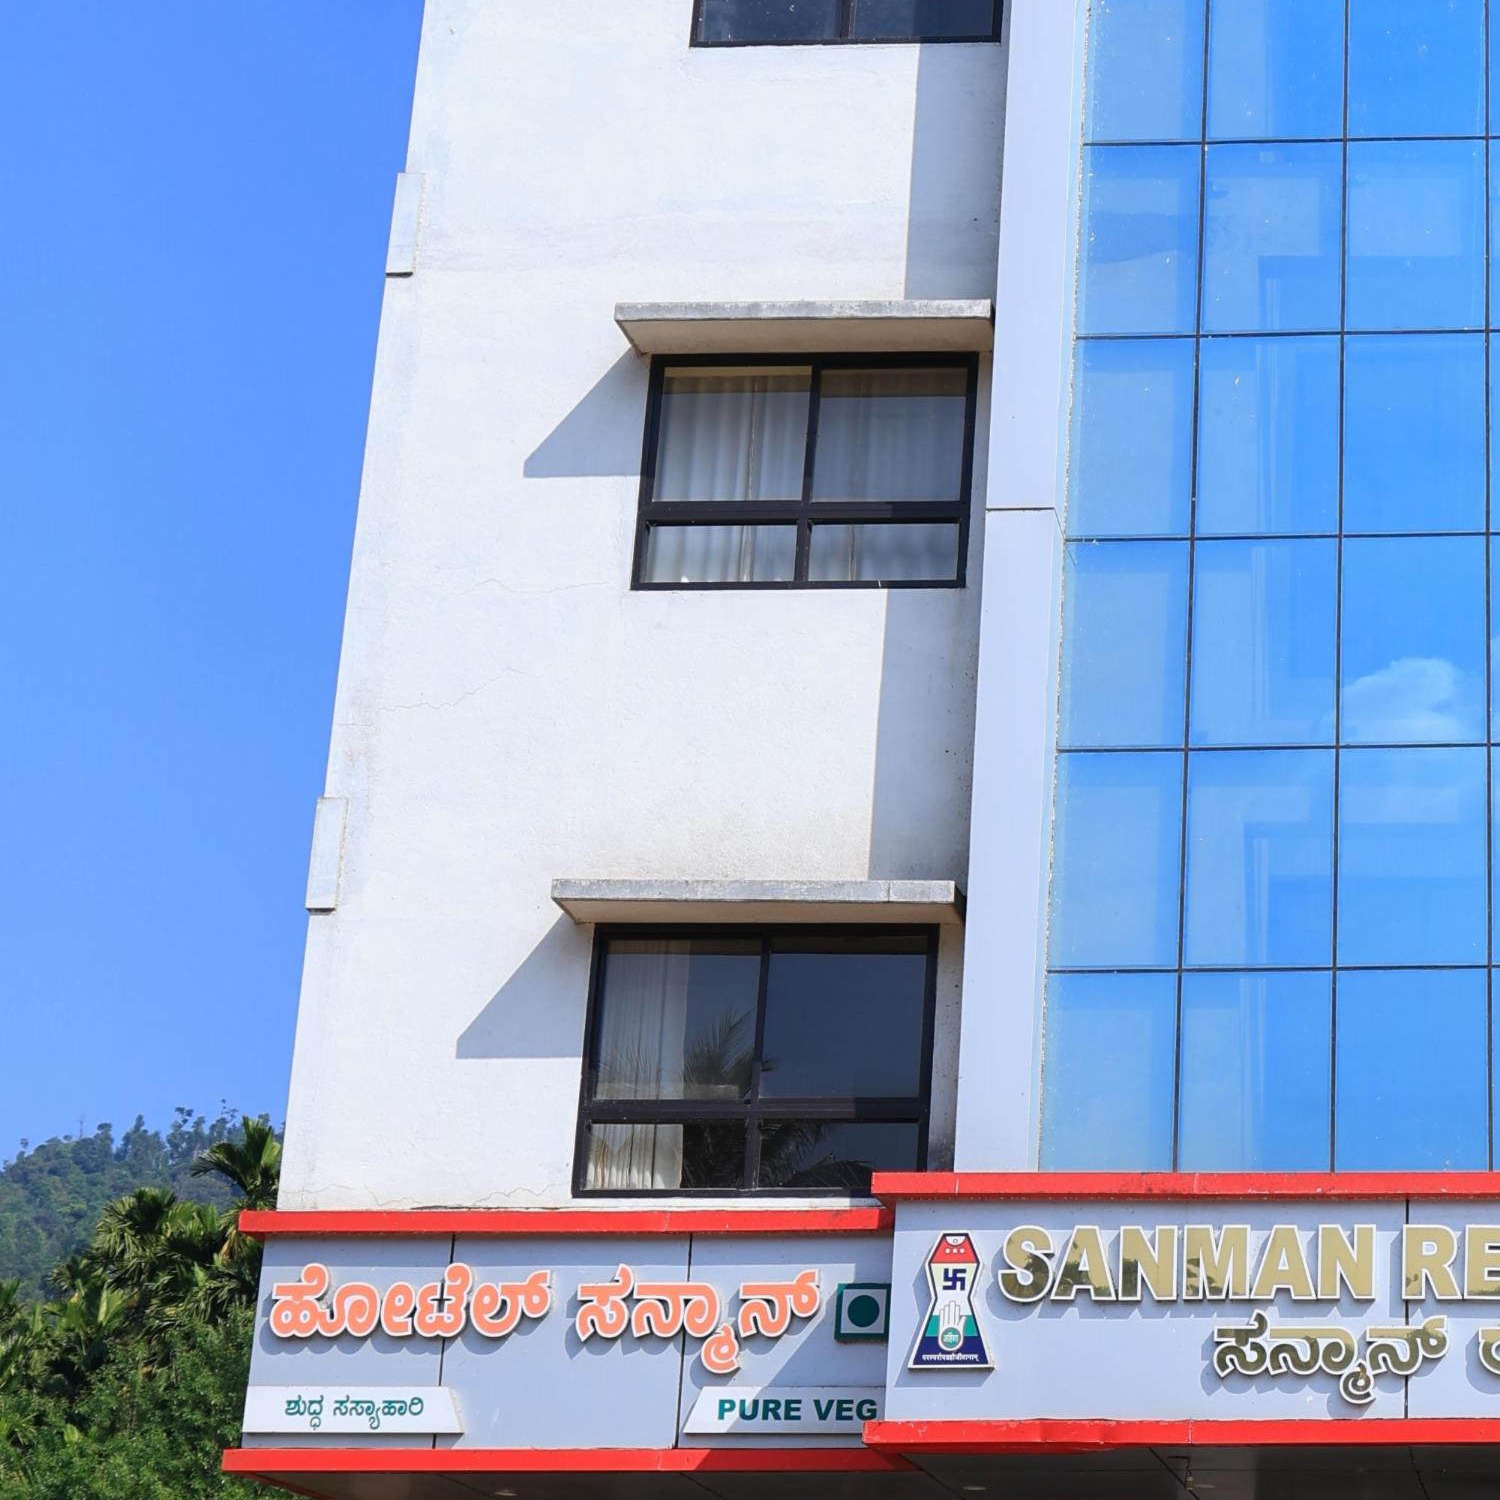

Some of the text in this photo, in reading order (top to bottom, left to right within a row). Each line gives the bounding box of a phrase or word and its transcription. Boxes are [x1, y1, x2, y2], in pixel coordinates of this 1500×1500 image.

[998, 1224, 1376, 1302] SANMAN
[269, 1262, 822, 1375] ಹೋಟೆಲ್ ಸನ್ಮಾನ್
[1213, 1308, 1449, 1405] ಸನ್ಮಾನ್
[285, 1394, 424, 1430] ಶುದ್ಧ ಸಸ್ಯಾಹಾರಿ
[717, 1399, 877, 1421] PURE VEG
